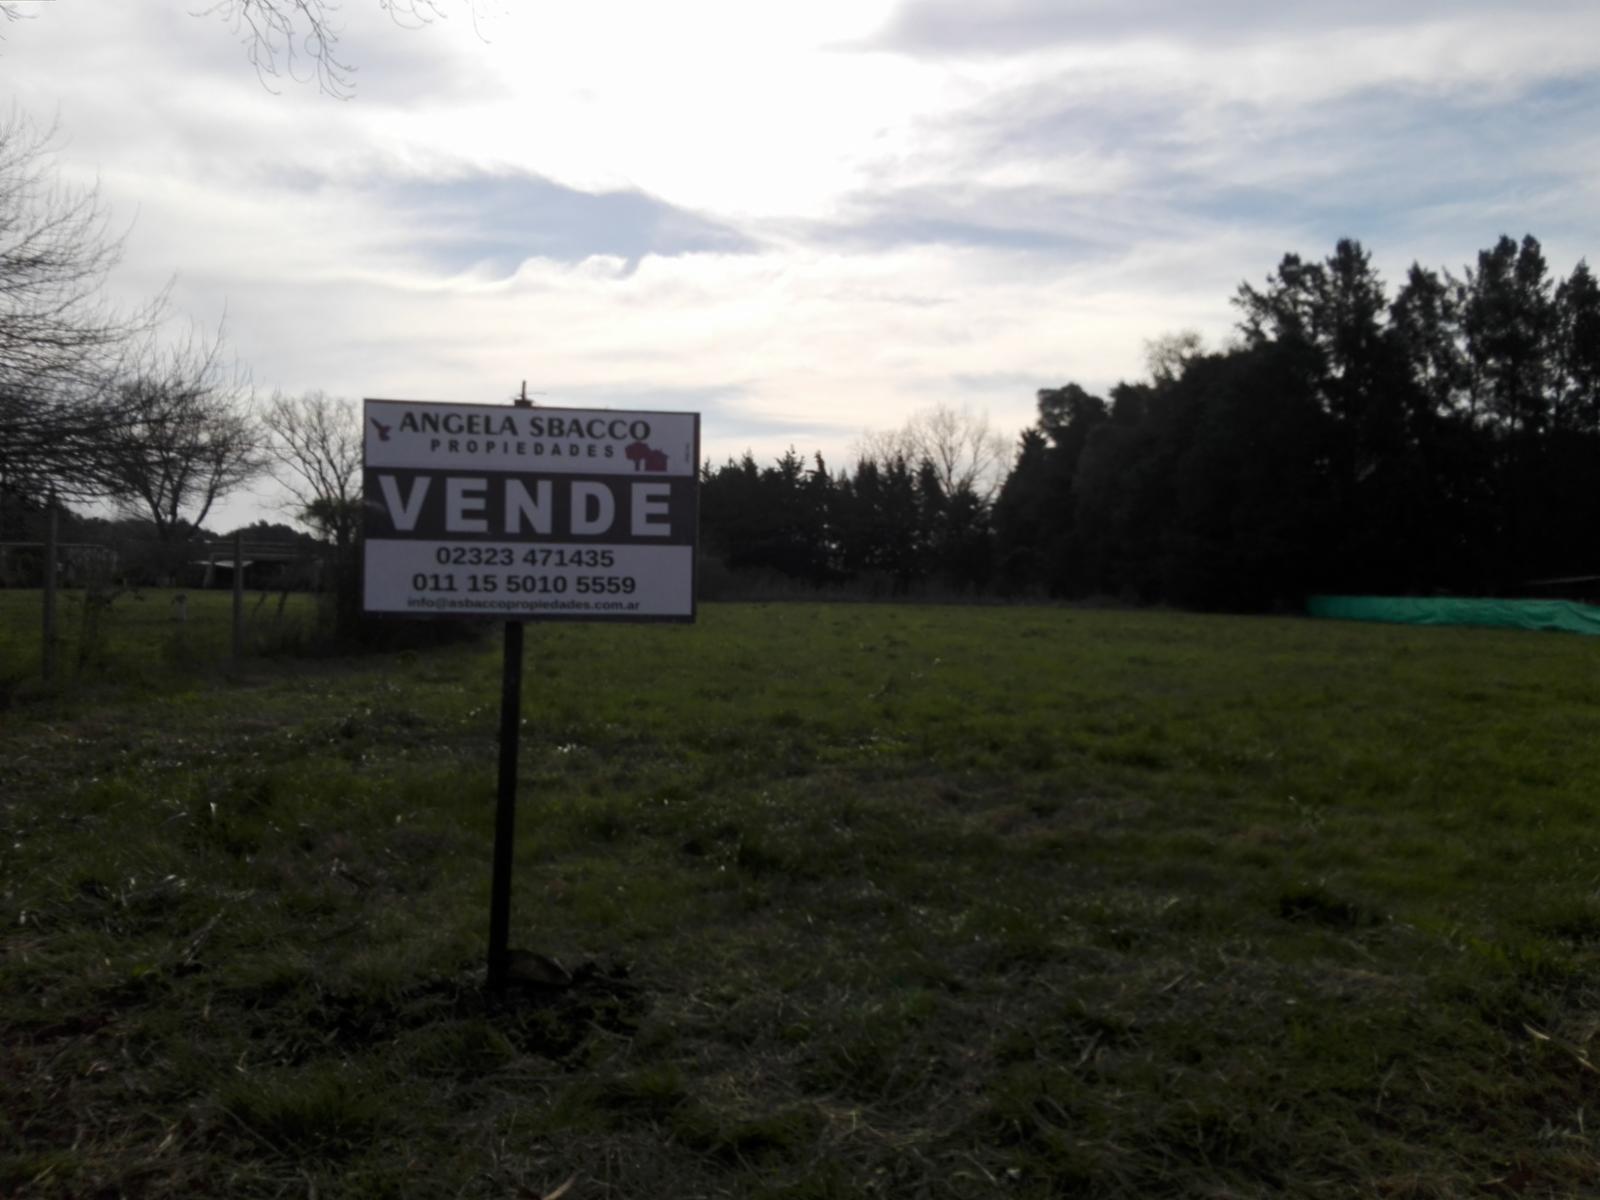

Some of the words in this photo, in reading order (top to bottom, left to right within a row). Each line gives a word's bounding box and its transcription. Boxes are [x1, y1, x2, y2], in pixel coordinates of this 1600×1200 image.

[400, 411, 519, 437] ANGELA
[530, 416, 651, 441] SBACCO
[430, 438, 615, 458] PROPIEDADES
[378, 475, 672, 536] VENDE
[436, 547, 514, 566] 02323
[522, 548, 614, 567] 471435
[412, 573, 456, 592] 011
[468, 574, 497, 592] 15
[506, 575, 568, 594] 5010
[576, 576, 636, 594] 5559
[407, 596, 640, 613] info@asbaccopropiedades.com.ar
